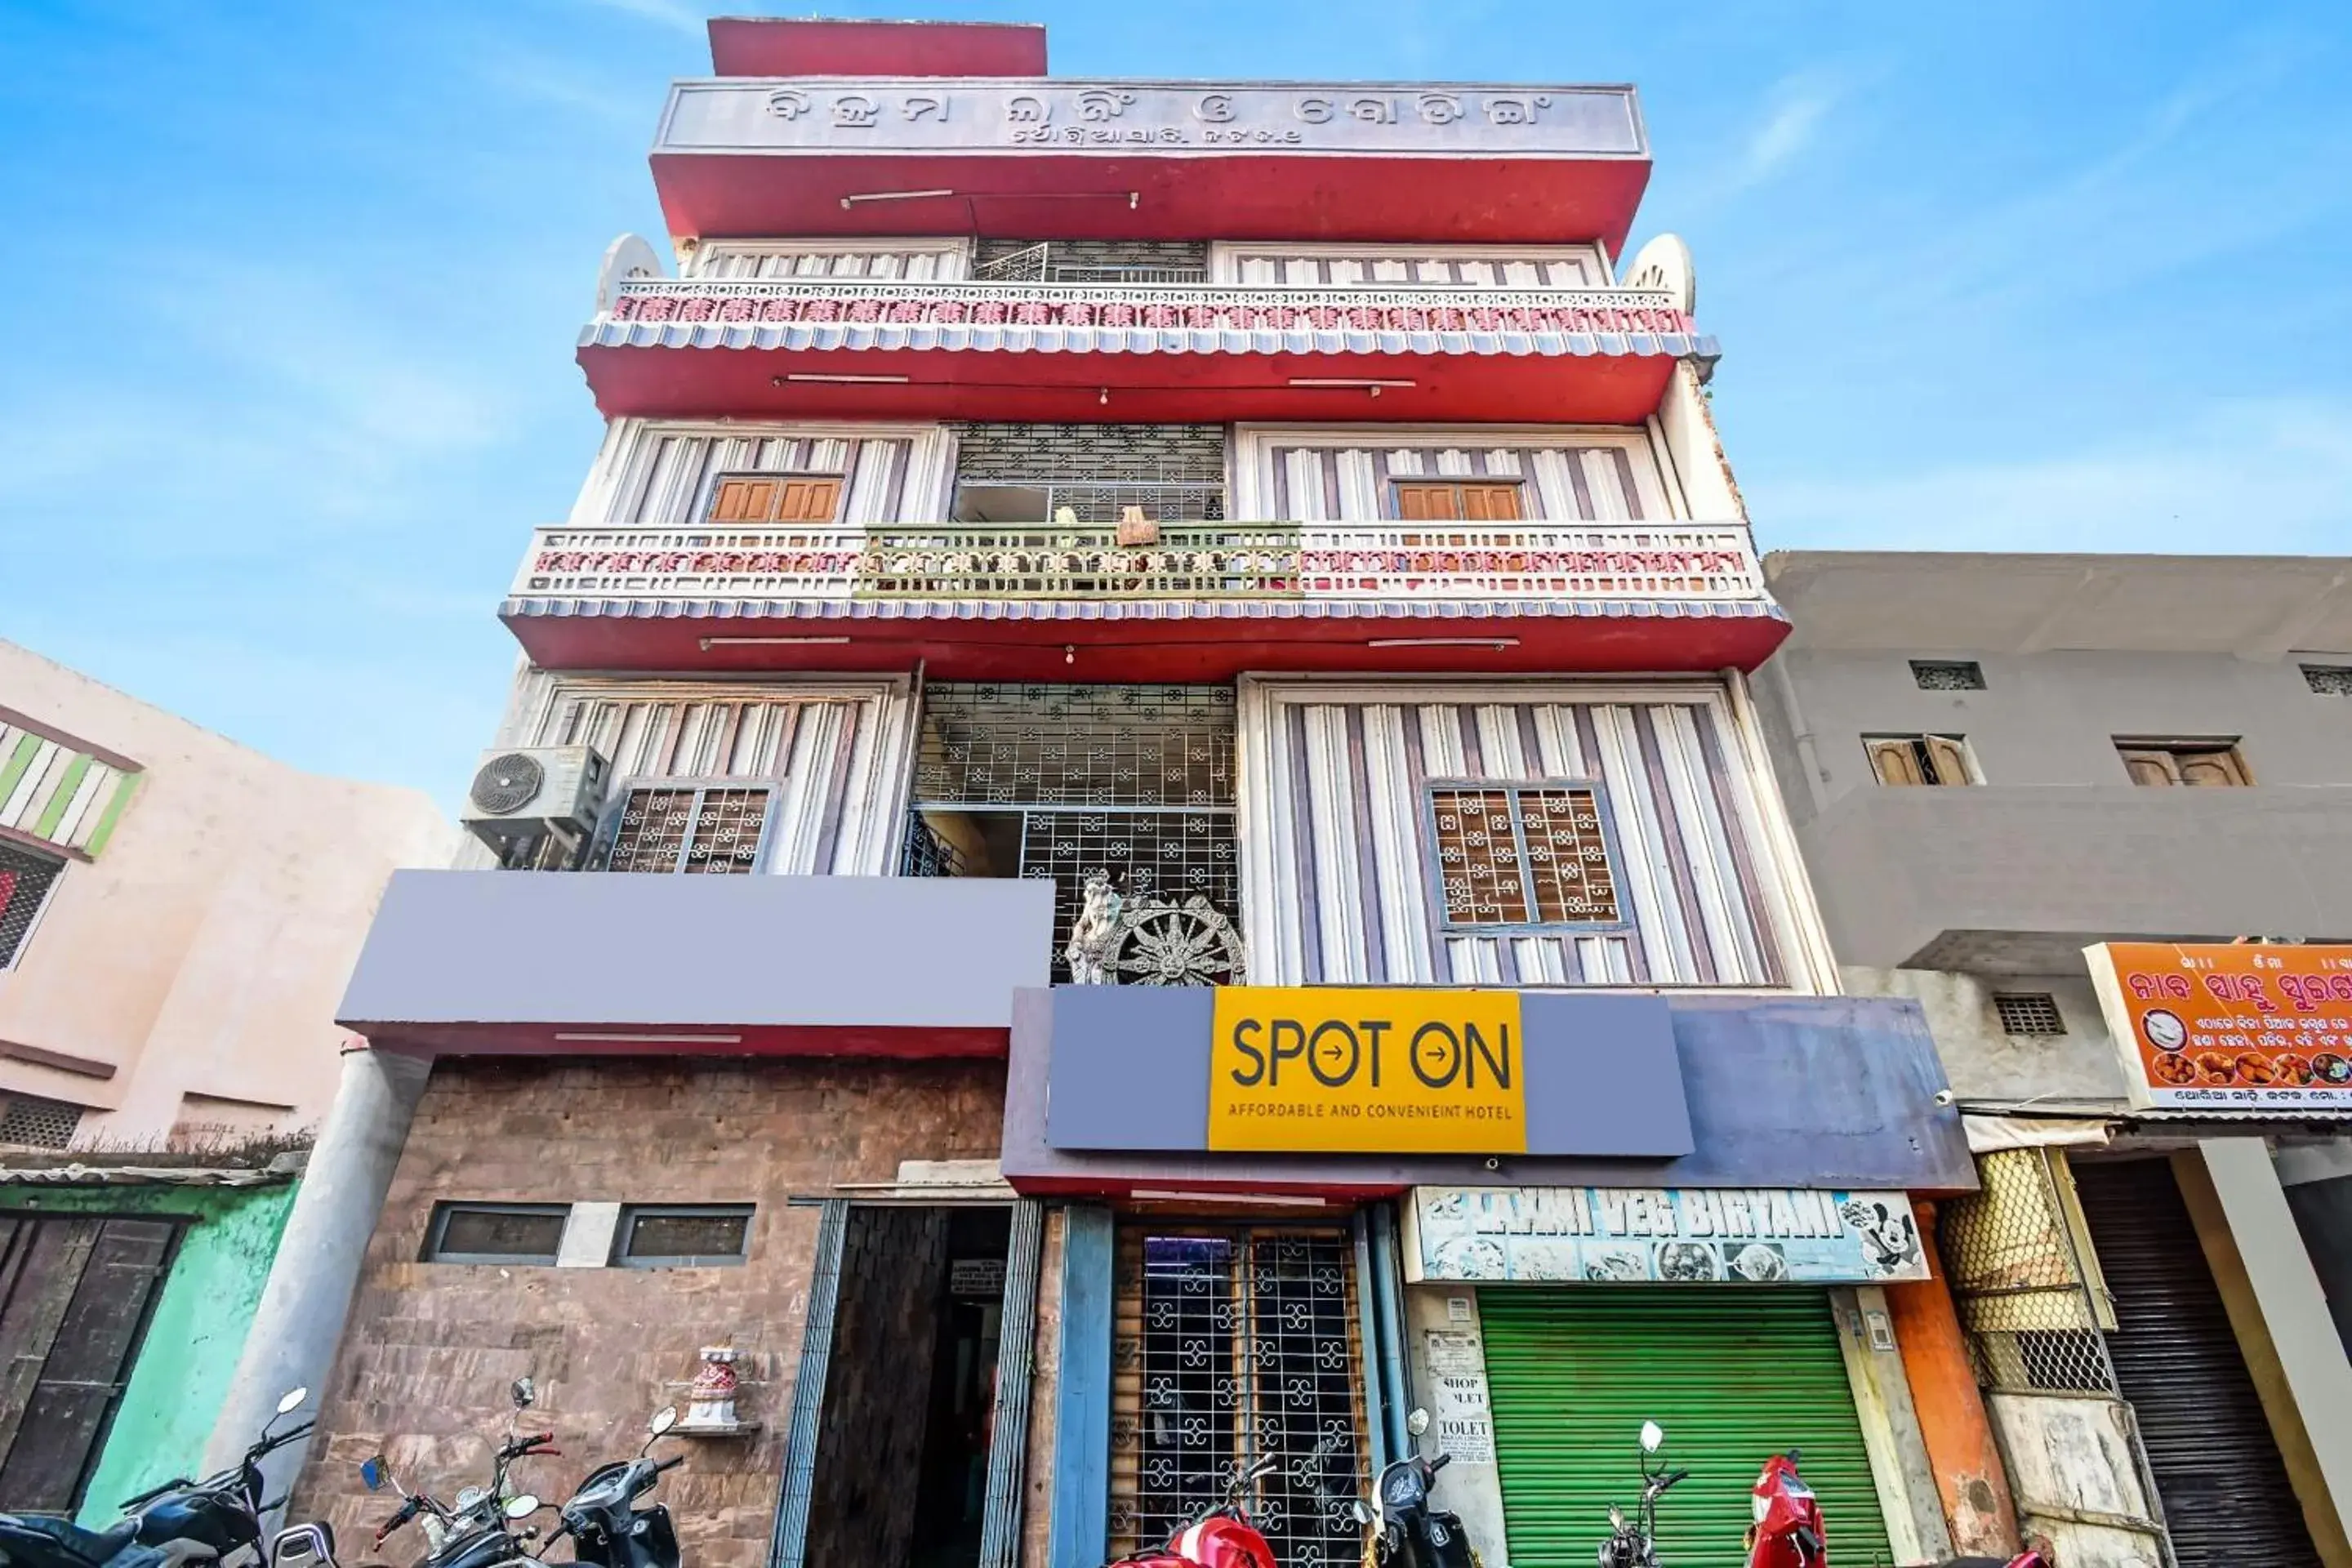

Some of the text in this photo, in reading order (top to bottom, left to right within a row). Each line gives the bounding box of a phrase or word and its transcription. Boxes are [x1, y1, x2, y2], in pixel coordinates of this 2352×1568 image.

[1231, 1018, 1511, 1089] SPOT ON
[1227, 1102, 1324, 1117] AFFORDABLE
[1330, 1103, 1361, 1117] AND
[1466, 1105, 1513, 1120] HOTEL
[1593, 1187, 1679, 1236] VEG
[1682, 1188, 1845, 1239] BIRYANI
[1443, 1378, 1478, 1388] SHOP
